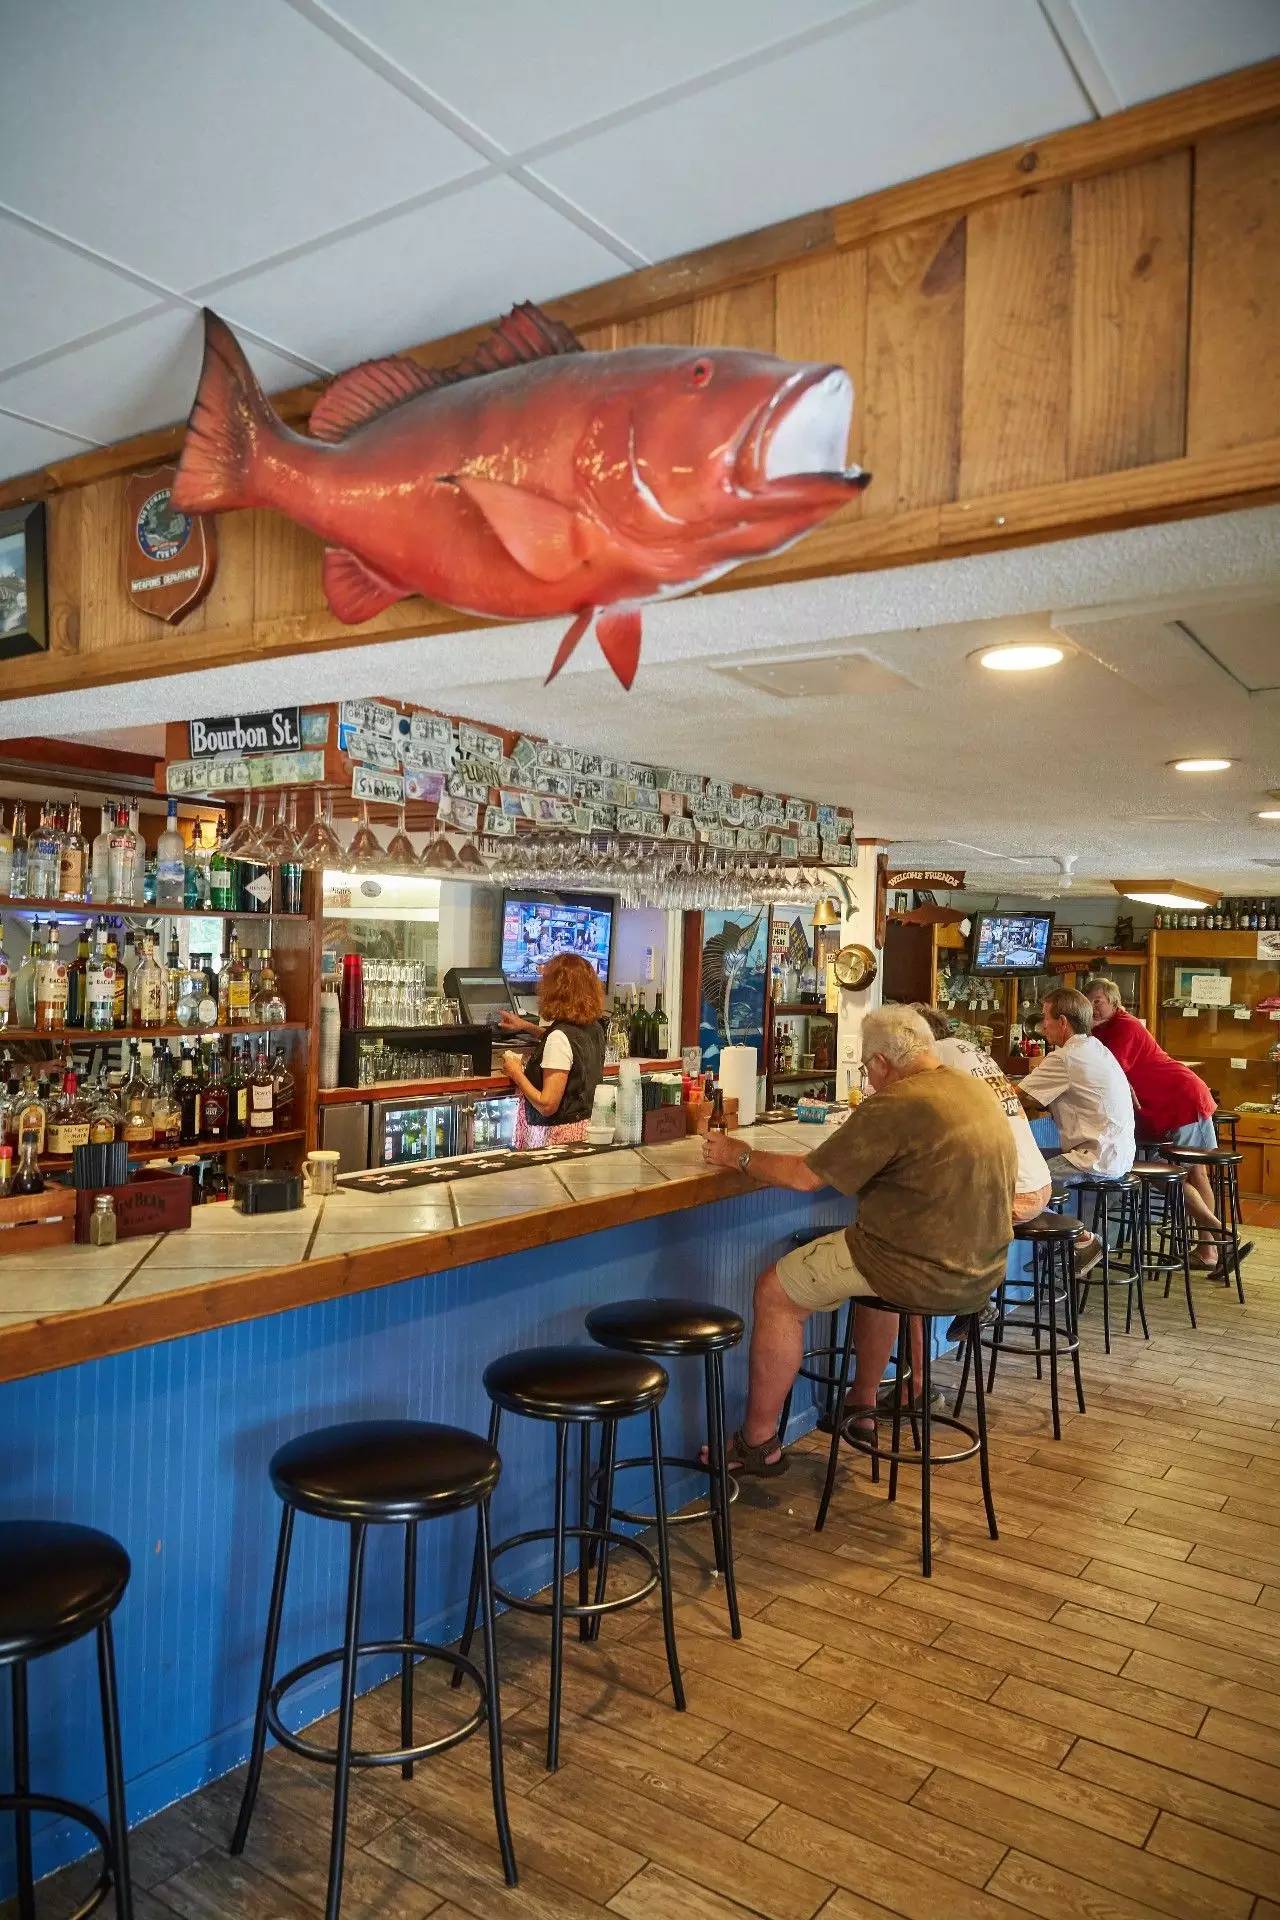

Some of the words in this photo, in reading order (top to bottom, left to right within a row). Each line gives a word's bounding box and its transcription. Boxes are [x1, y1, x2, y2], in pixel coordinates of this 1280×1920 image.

[131, 577, 161, 592] WEAPONS
[163, 567, 200, 586] DEPARTMENT
[193, 717, 268, 753] Bourbon
[272, 713, 298, 746] St.
[888, 871, 922, 887] WELCOME
[925, 871, 960, 887] FRIENDS
